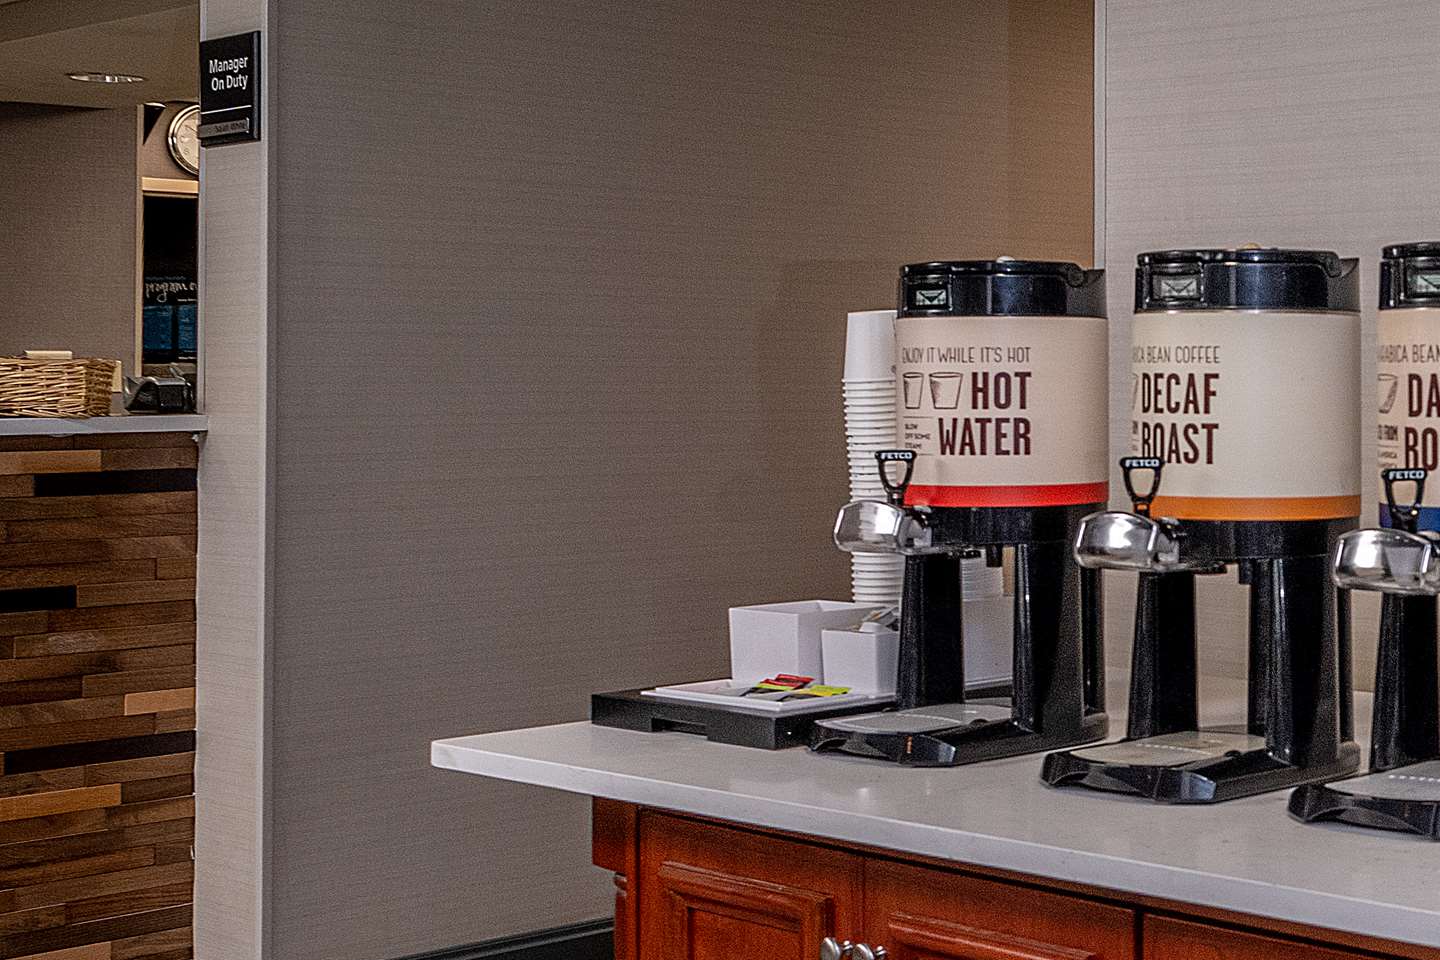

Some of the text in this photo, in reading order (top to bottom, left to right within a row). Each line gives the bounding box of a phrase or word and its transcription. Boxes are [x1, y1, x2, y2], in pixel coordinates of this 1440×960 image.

[209, 56, 248, 74] Manager
[211, 74, 248, 91] On Duty
[927, 347, 936, 363] IT
[938, 347, 975, 363] WHILE
[981, 346, 1002, 363] IT'S
[1008, 347, 1031, 363] HOT
[1147, 346, 1170, 363] BEAN
[1175, 346, 1220, 363] COFFEE
[971, 372, 1032, 410] HOT
[1142, 373, 1219, 414] DECAF
[938, 418, 1031, 455] WATER
[1142, 422, 1219, 464] ROAST
[880, 452, 912, 460] FETCO
[1125, 459, 1160, 468] FETCO
[1388, 470, 1425, 480] FETCO
